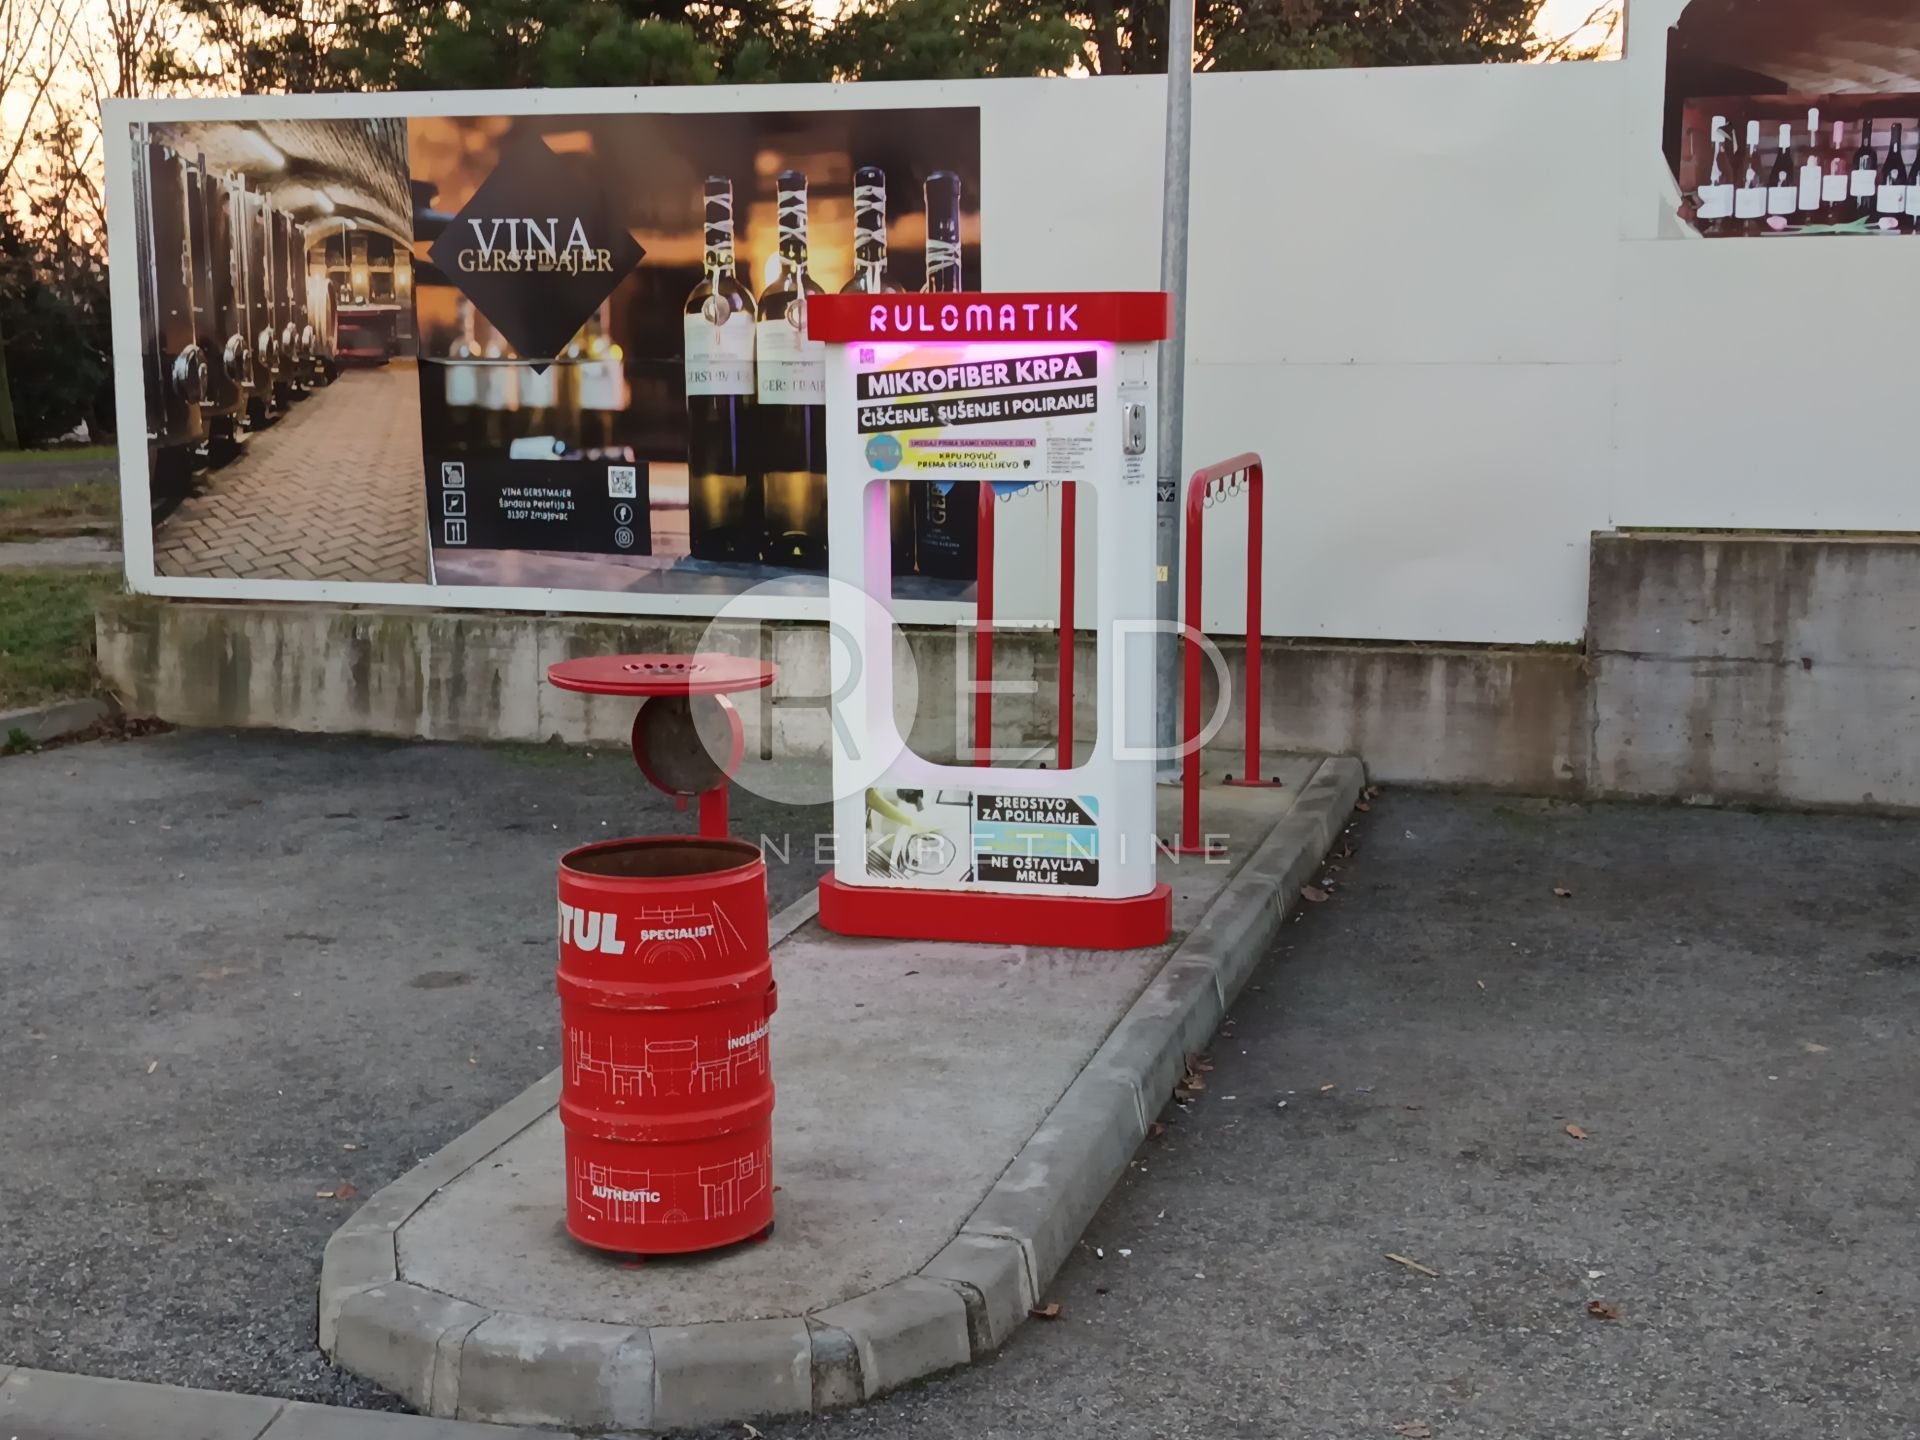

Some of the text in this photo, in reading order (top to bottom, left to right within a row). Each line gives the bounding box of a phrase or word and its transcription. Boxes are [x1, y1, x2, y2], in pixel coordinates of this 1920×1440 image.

[468, 217, 597, 262] VINA
[868, 356, 1083, 397] MIKROFIBER KRPA
[861, 392, 1095, 427] ČIŠĆENJE, SUŠENJE I POLIRANJE
[917, 461, 945, 469] PREMA
[502, 487, 521, 497] VINA
[995, 796, 1066, 811] SREDSTVO
[982, 808, 1079, 824] ZA POLIRANJE
[991, 855, 1084, 872] NE OSTAVLJA
[1016, 870, 1058, 884] MRLJE
[558, 900, 625, 955] TUL
[641, 924, 714, 941] SPECIALIST
[592, 1185, 661, 1203] AUTHENTIC
